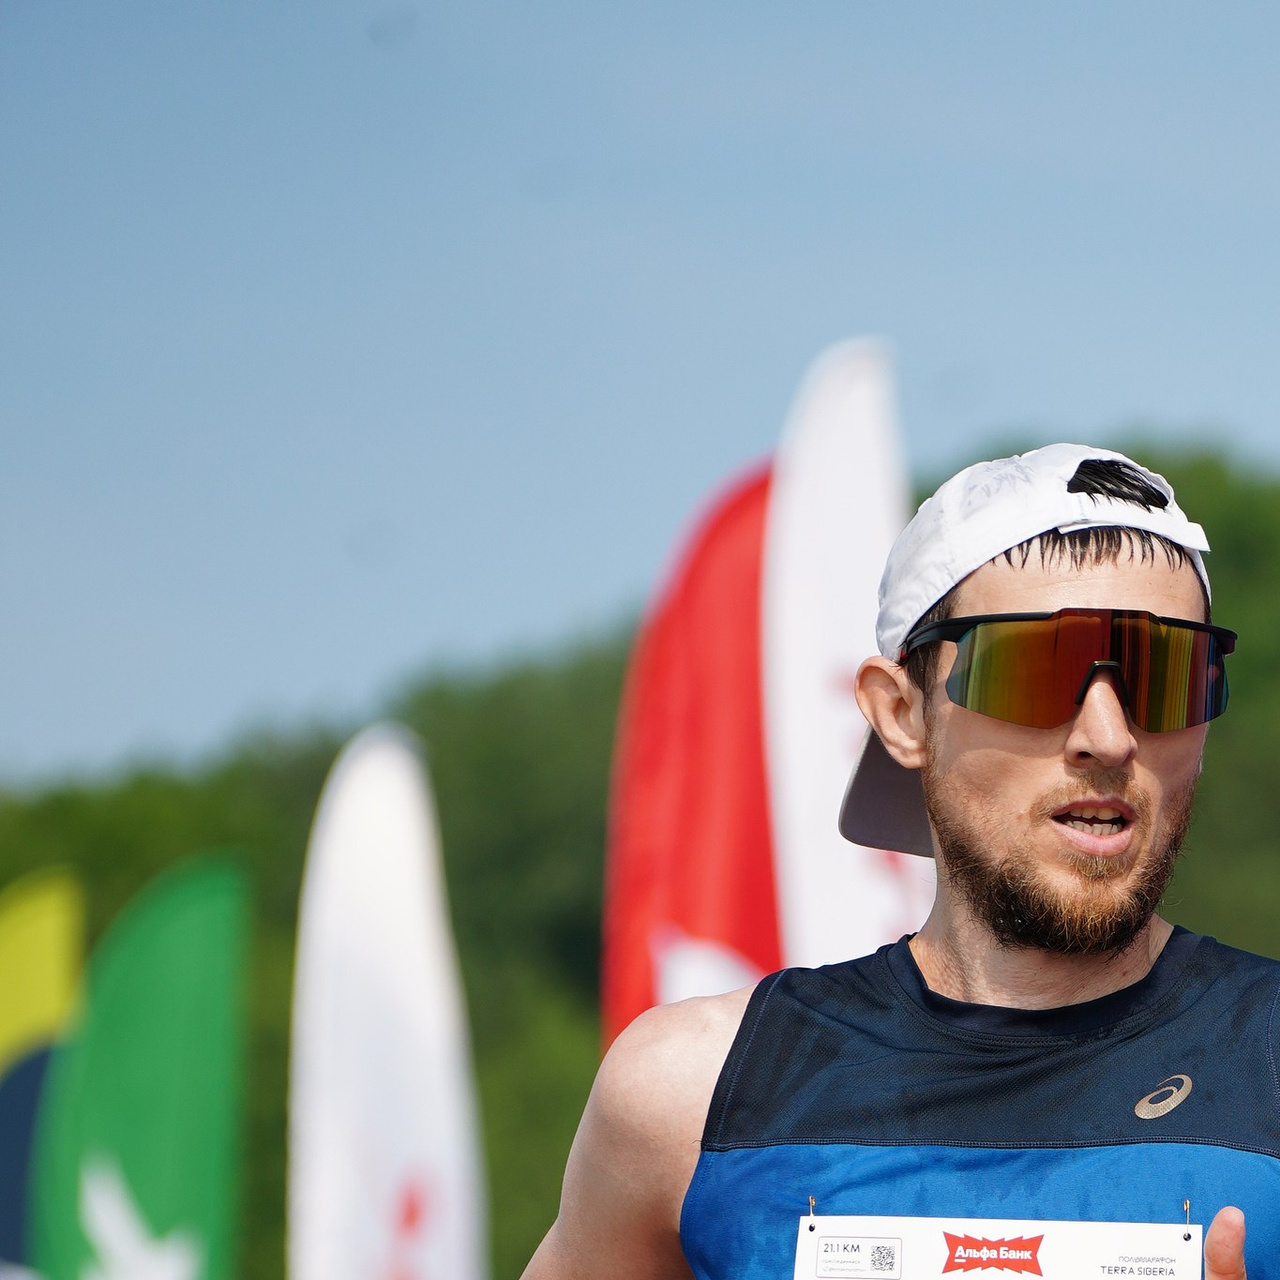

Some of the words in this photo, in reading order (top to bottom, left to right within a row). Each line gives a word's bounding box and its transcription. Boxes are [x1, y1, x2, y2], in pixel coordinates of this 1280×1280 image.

[823, 1243, 840, 1253] 21.1
[954, 1245, 998, 1262] Альфа
[999, 1246, 1033, 1260] Банк
[1100, 1266, 1135, 1275] TERRA
[1137, 1267, 1176, 1276] SIBERIA
